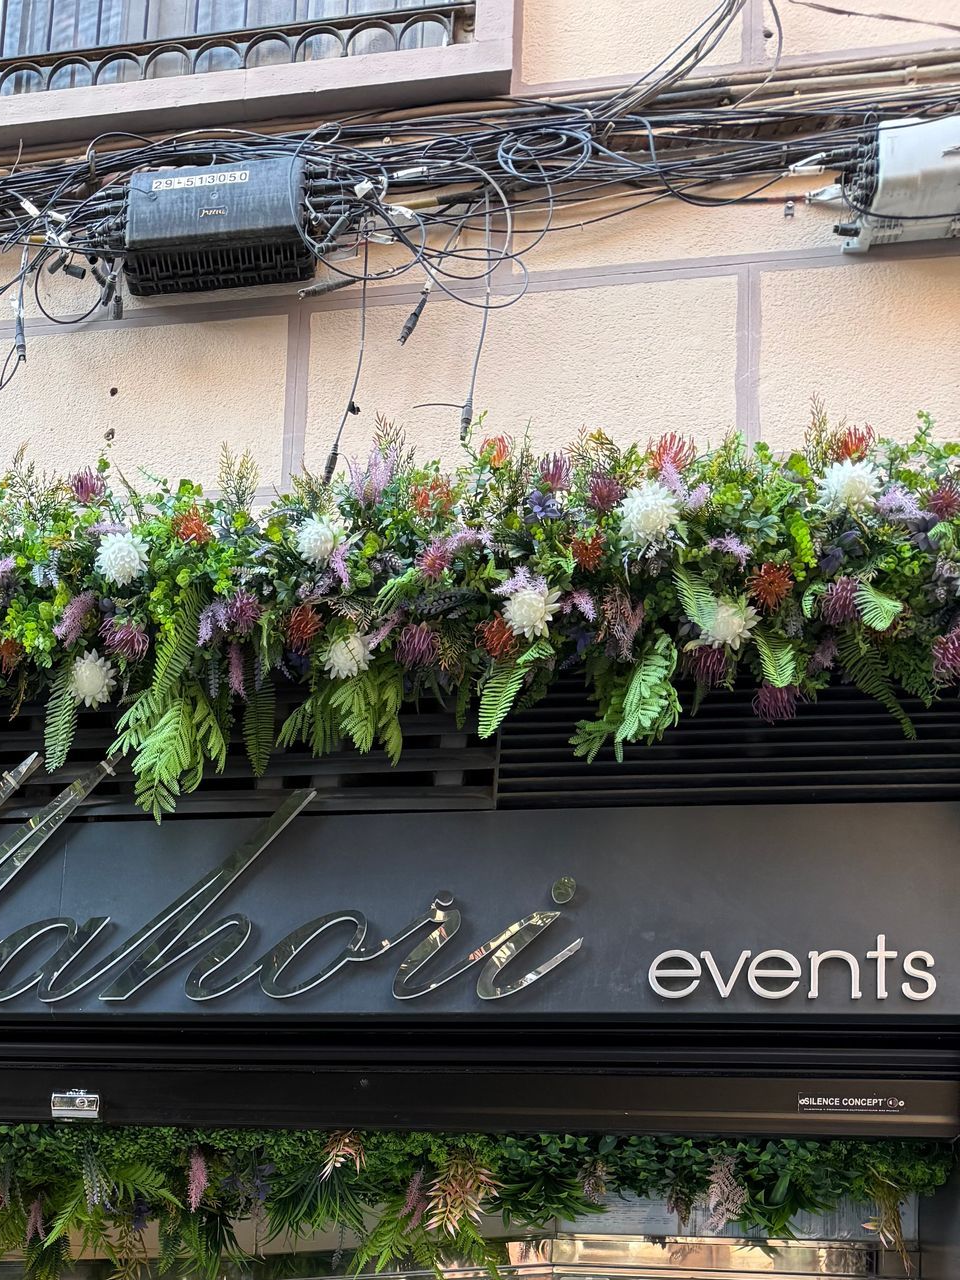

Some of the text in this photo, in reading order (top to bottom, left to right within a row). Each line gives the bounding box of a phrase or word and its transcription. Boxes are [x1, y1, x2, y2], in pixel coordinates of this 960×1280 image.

[153, 171, 248, 190] 29-513050
[647, 933, 938, 1002] events
[804, 1097, 840, 1106] SILENCE
